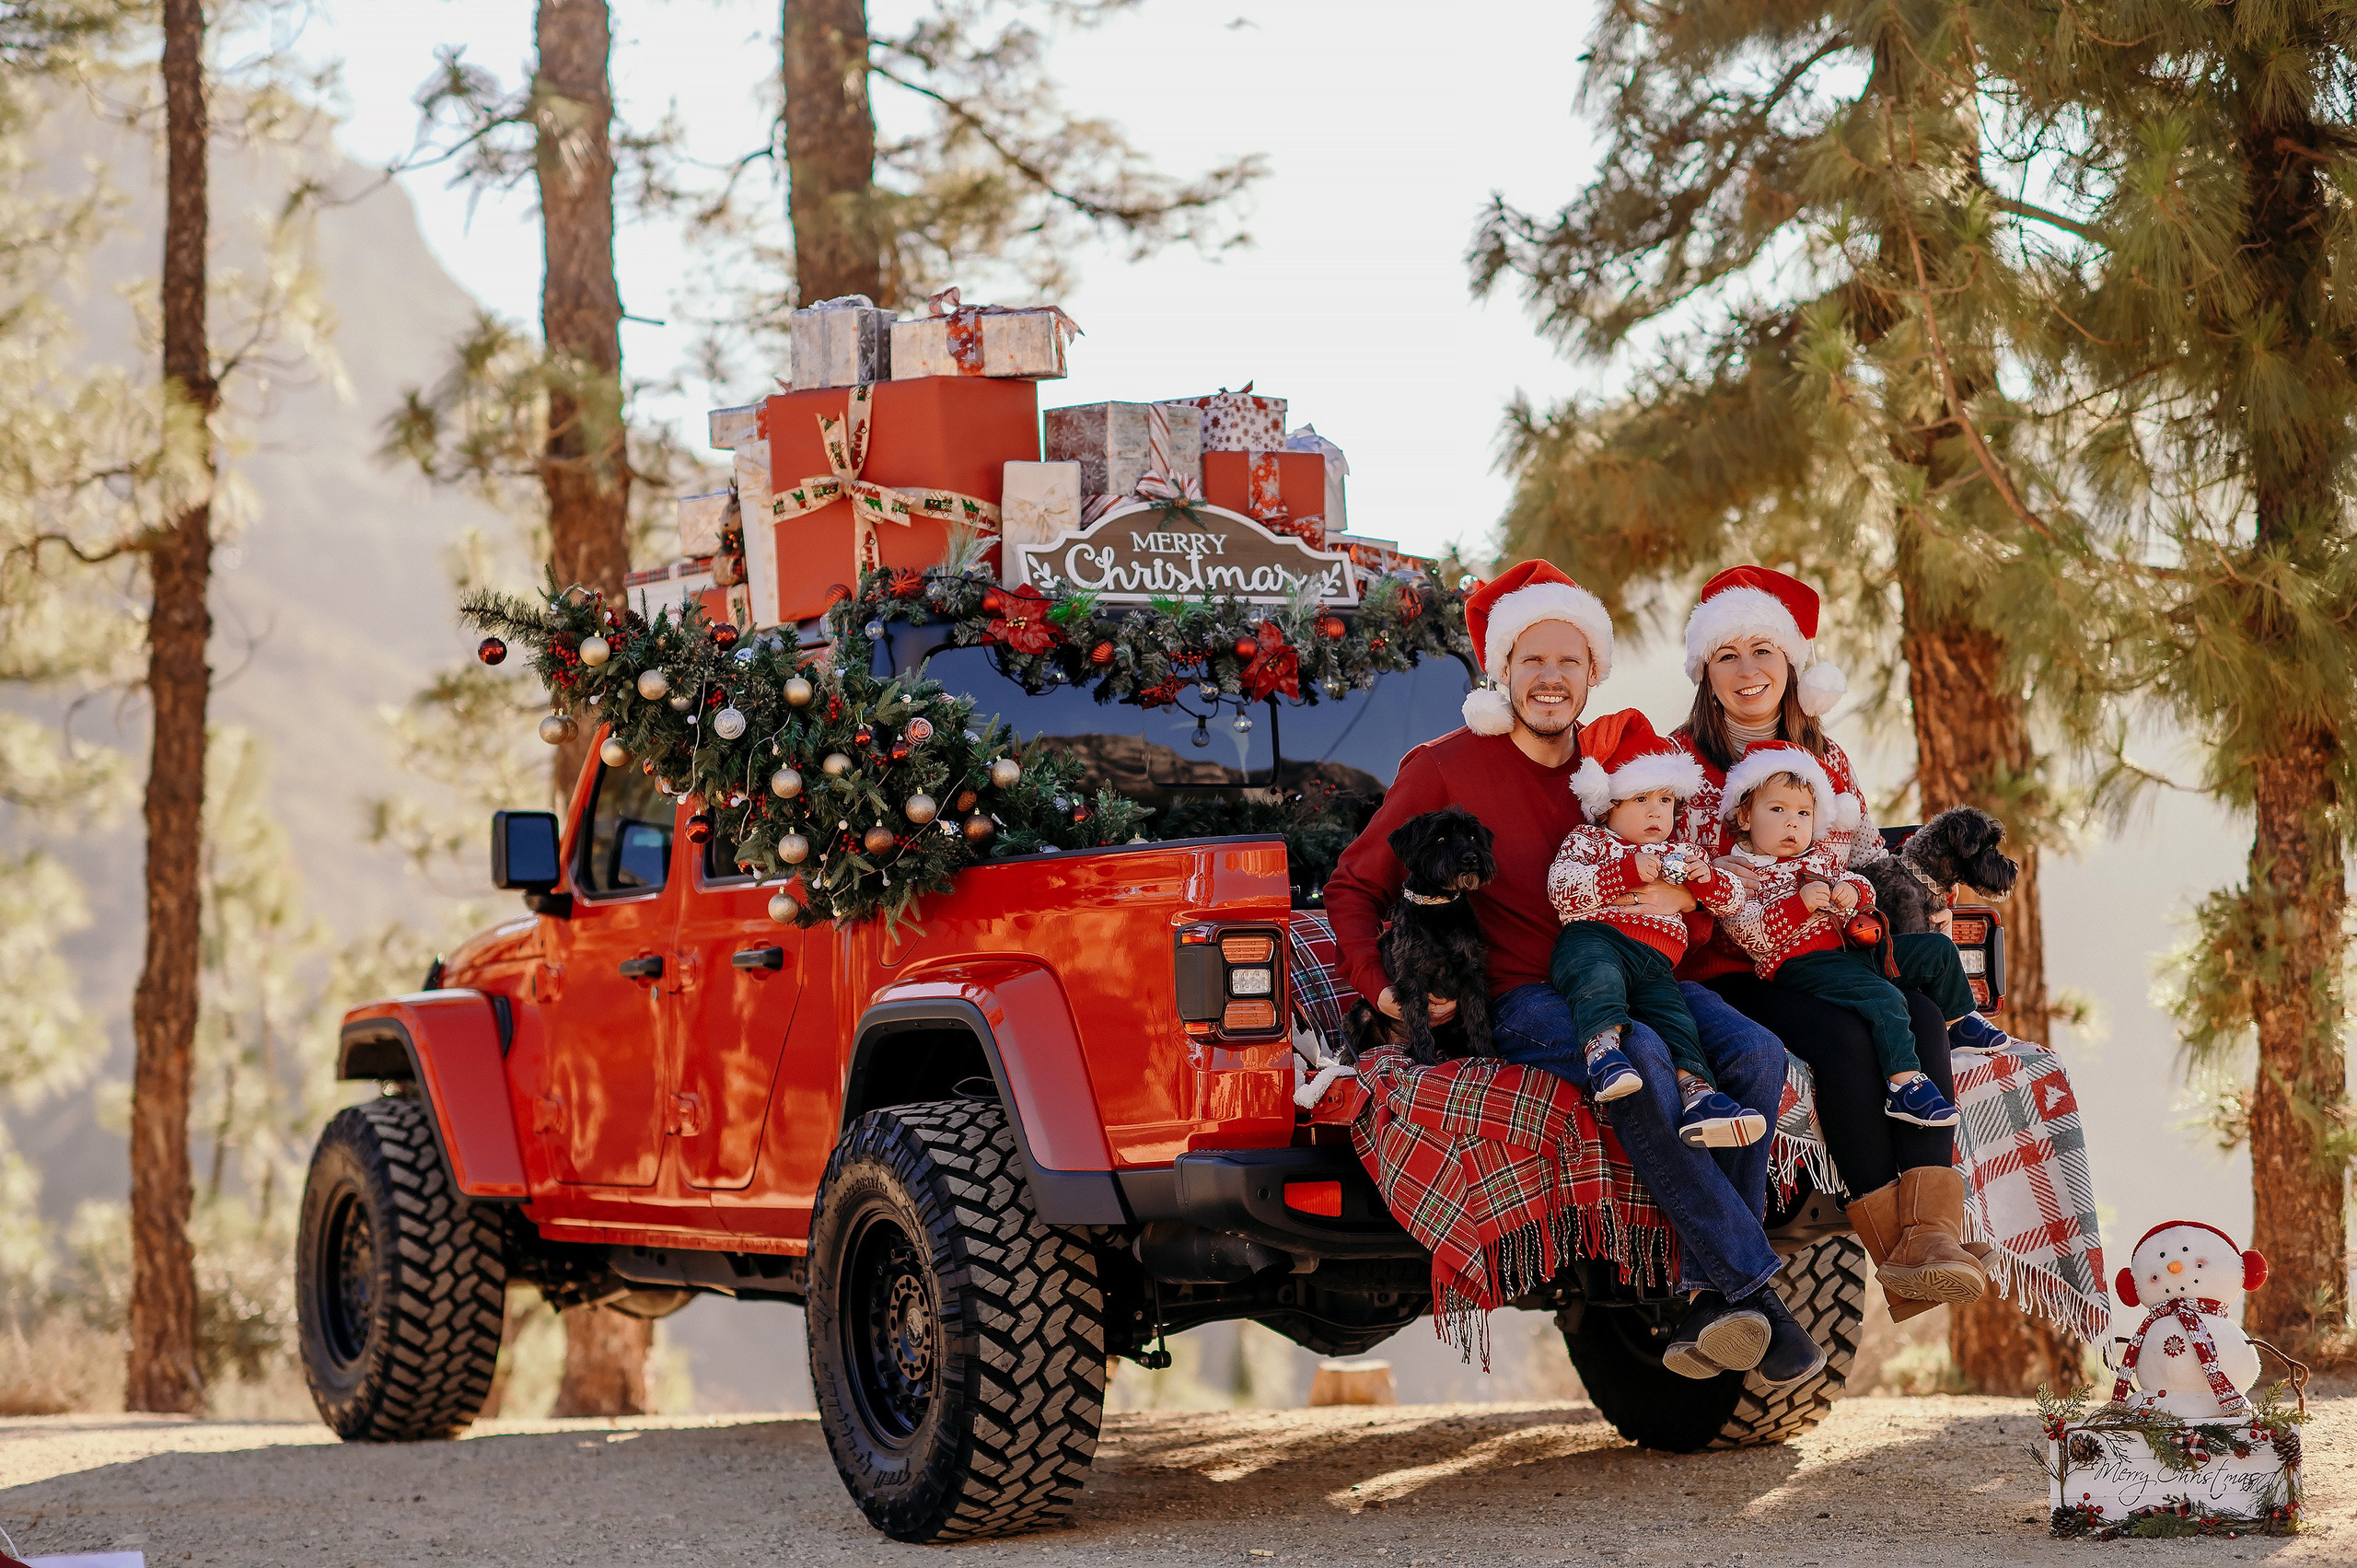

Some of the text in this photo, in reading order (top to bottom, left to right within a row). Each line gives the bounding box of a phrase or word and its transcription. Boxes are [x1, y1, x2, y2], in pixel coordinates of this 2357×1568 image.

[1130, 530, 1227, 554] MERRY
[1064, 542, 1307, 594] Christmas
[2091, 1456, 2157, 1506] Merry
